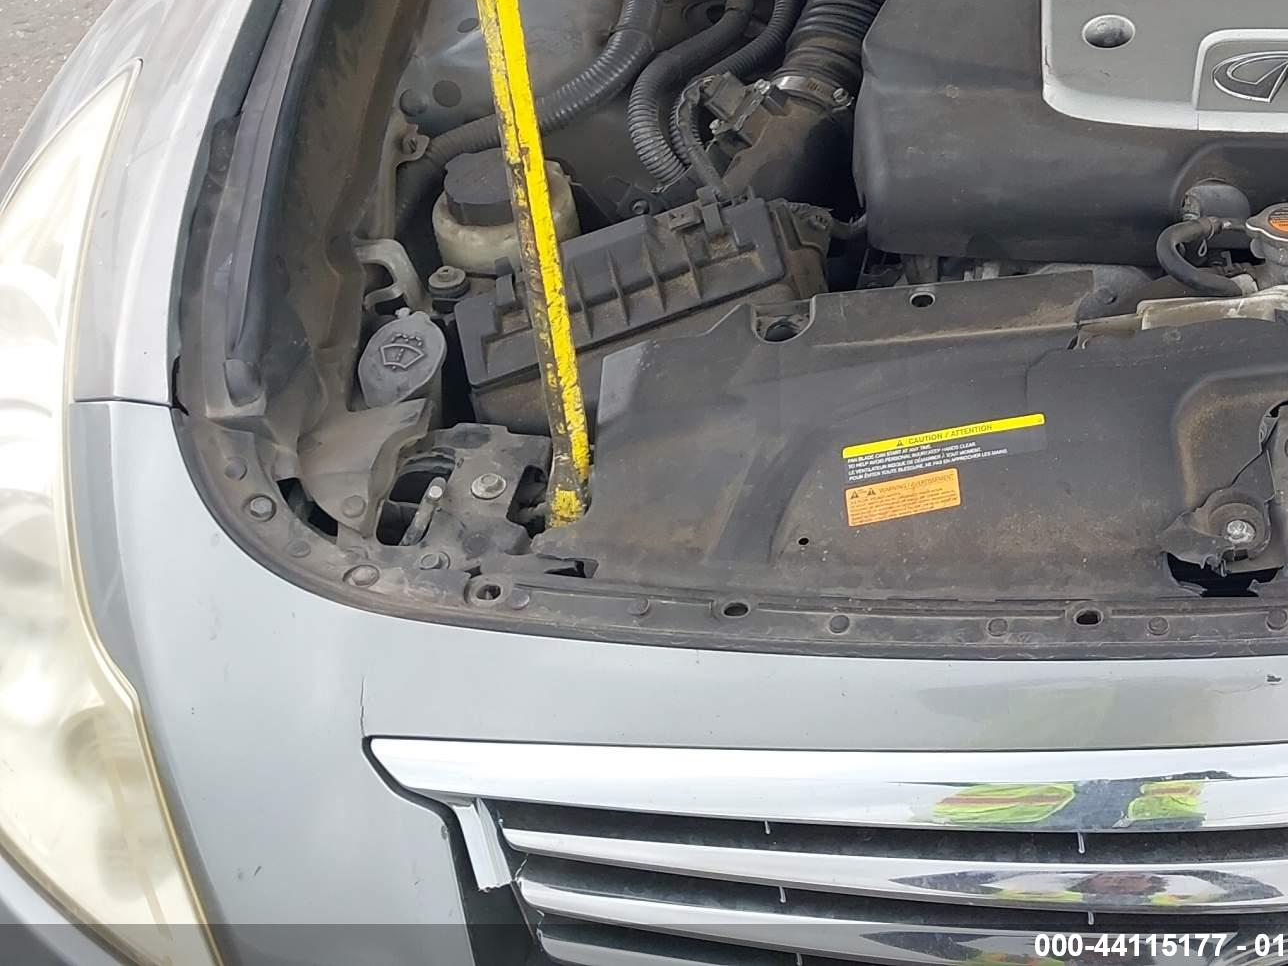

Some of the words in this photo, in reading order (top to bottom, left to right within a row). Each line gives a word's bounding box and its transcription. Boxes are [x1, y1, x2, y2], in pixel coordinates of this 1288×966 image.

[908, 434, 942, 444] CAUTION
[951, 425, 992, 436] ATTENTION
[856, 460, 869, 468] HELP
[870, 457, 884, 465] AVOID
